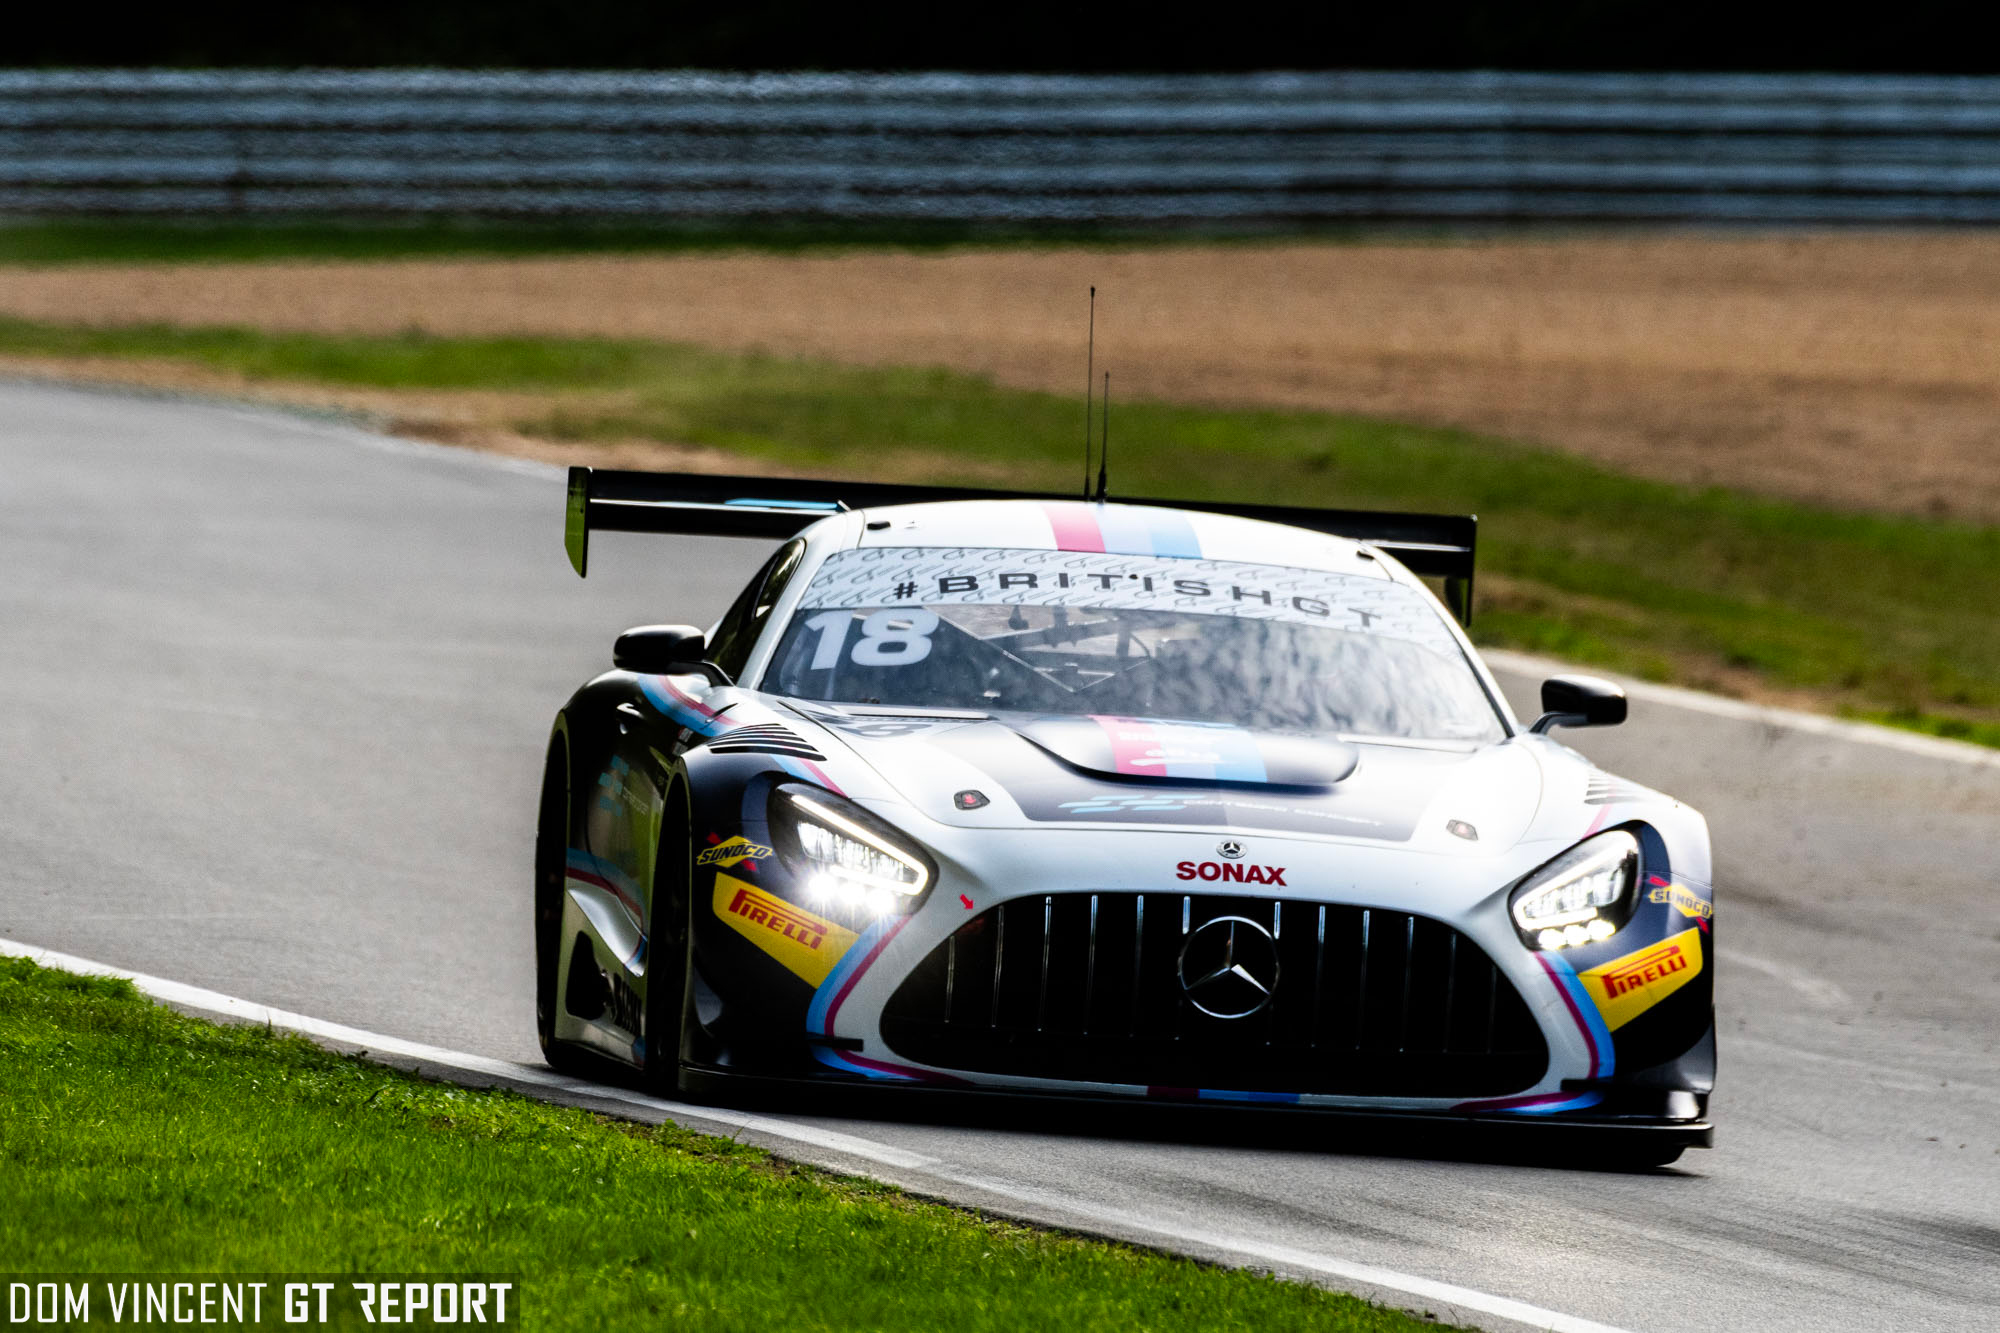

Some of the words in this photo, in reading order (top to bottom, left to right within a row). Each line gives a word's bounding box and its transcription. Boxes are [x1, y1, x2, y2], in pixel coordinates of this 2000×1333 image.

[805, 607, 940, 670] 18
[700, 844, 771, 865] SUNOCO
[1176, 861, 1287, 887] SONAX
[728, 888, 828, 951] PIRELLI
[1601, 945, 1687, 999] PIRELLI
